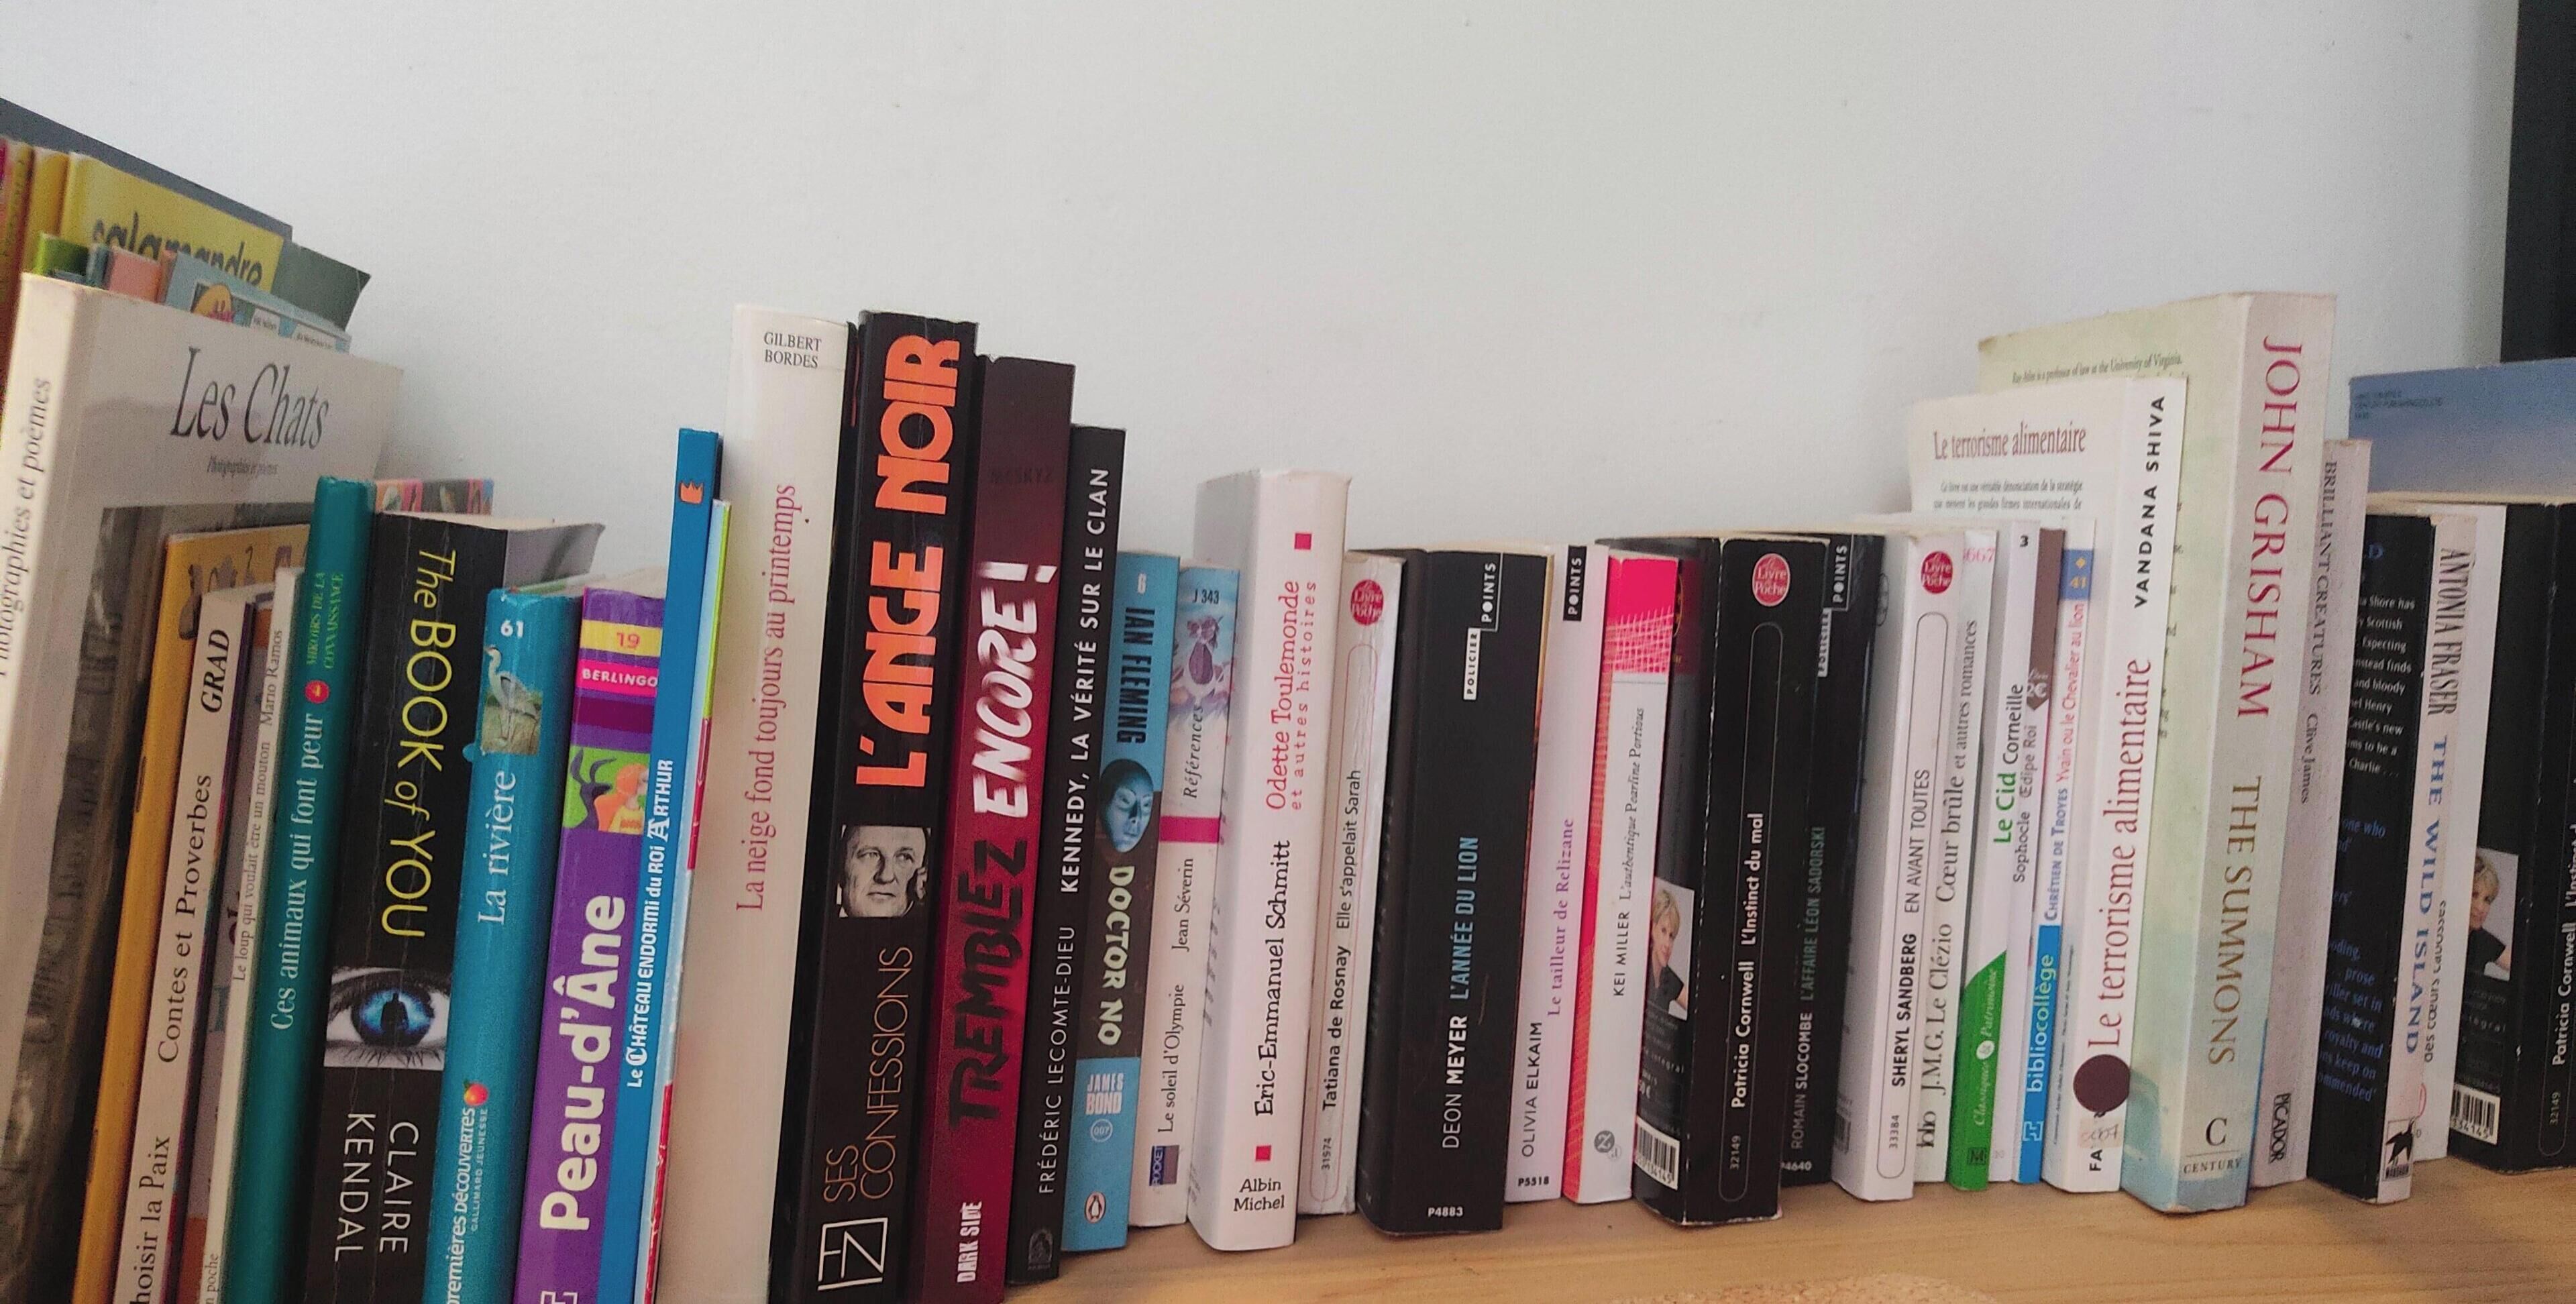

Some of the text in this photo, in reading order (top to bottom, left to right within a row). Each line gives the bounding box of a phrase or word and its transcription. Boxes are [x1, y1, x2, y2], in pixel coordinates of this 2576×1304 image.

[763, 331, 822, 351] GILBERT
[763, 349, 819, 368] BORDES
[170, 346, 329, 449] Les Chats
[1933, 419, 2087, 460] Le terrorisme alimentaire
[2134, 395, 2166, 608] VANDANA SHIVA
[2237, 335, 2302, 718] JOHN GRISHAM
[855, 334, 961, 787] L'ANGE NOIR
[1481, 561, 1497, 623] POINTS
[1567, 557, 1582, 616] POINTS
[1755, 582, 1786, 595] Poche
[1758, 567, 1787, 580] Livre
[1833, 545, 1847, 602] POINTS
[2307, 461, 2338, 696] BRILLIANT CREATURES
[201, 628, 230, 712] GRAD
[500, 620, 524, 638] 61
[616, 631, 640, 649] 19
[1467, 632, 1479, 695] POLICIER
[2362, 637, 2407, 654] Expecting
[2367, 618, 2403, 631] Scottish
[2427, 548, 2471, 716] ANTONIA FRASER
[262, 631, 282, 725] Mario Ramos
[582, 667, 658, 688] BERLINGO
[735, 484, 802, 912] La neige fond toujours au printemps
[1060, 469, 1109, 893] KENNEDY, LA VÉRITÉ SUR LE CLAN
[1116, 607, 1155, 744] IAN FLEMING
[1267, 580, 1299, 810] Odette Toulemonde
[1291, 581, 1317, 810] et autres histoires
[301, 713, 324, 770] peur
[381, 549, 457, 937] The BOOK of YOU
[1183, 705, 1203, 800] Références
[1625, 761, 1641, 813] Pearline
[1936, 619, 1977, 902] Cœur brûle et autres romances
[1993, 684, 2024, 845] Le Cid Corneille
[2349, 758, 2381, 773] Charlie
[2428, 735, 2447, 806] THE
[290, 777, 317, 824] font
[478, 769, 517, 925] La rivière
[1905, 769, 1930, 914] EN AVANT TOUTES
[289, 834, 315, 870] qui
[1336, 769, 1361, 930] Elle s'appelait Sarah
[1619, 816, 1640, 900] L'authentique
[1741, 813, 1764, 945] L'Instinct du mal
[2088, 659, 2151, 1047] Le terrorisme alimentaire
[2419, 820, 2440, 915] WILD
[158, 775, 212, 1063] Contes et Proverbes
[279, 879, 307, 979] animaux
[1171, 858, 1194, 953] Jean Séverin
[1548, 818, 1574, 1017] Le tailleur de Relizane
[2208, 774, 2263, 1066] THE SUMMONS
[948, 839, 1027, 1131] TREMBLEZ
[1097, 865, 1136, 1046] DOCTOR NO
[1254, 840, 1291, 1117] Eric-Emmanuel Schmitt
[1442, 836, 1479, 1149] DEON MEYER L'ANNÉE DU LION
[1613, 912, 1630, 997] KEI MILLER
[2345, 967, 2375, 987] prose
[2406, 927, 2430, 1054] ISLAND
[270, 987, 297, 1030] Ces
[1322, 946, 1352, 1111] Tatiana de Rosnay
[1731, 960, 1756, 1109] Patricia Cornwell
[1891, 933, 1917, 1088] SHERYL SANDBERG
[2026, 954, 2057, 1093] bibliocollège
[2552, 1003, 2571, 1067] Patricia
[539, 894, 627, 1231] Peau-d'Âne
[860, 946, 914, 1200] CONFESSIONS
[1038, 926, 1075, 1194] FRÉDÉRIC LECOMTE-DIEU
[1085, 1091, 1122, 1116] BOND
[1086, 1073, 1124, 1092] JAMES
[1159, 984, 1185, 1133] Le soleil d'Olympie
[1521, 1022, 1543, 1158] OLIVIA ELKAIM
[1791, 1011, 1813, 1150] ROMAIN SLOCOMBE
[471, 1108, 488, 1232] GALLIMARD JEUNESSE
[823, 1144, 860, 1203] SES
[1093, 1126, 1110, 1136] 007
[2182, 1156, 2243, 1175] CENTURY
[2267, 1093, 2290, 1164] PICADOR
[334, 1113, 376, 1262] KENDAL
[379, 1120, 419, 1254] CLAIRE
[1233, 1195, 1285, 1212] Michel
[1239, 1177, 1283, 1193] Albin
[1428, 1207, 1464, 1218] P4883
[1517, 1176, 1550, 1187] P5518
[957, 1201, 983, 1283] DARK SIDE
